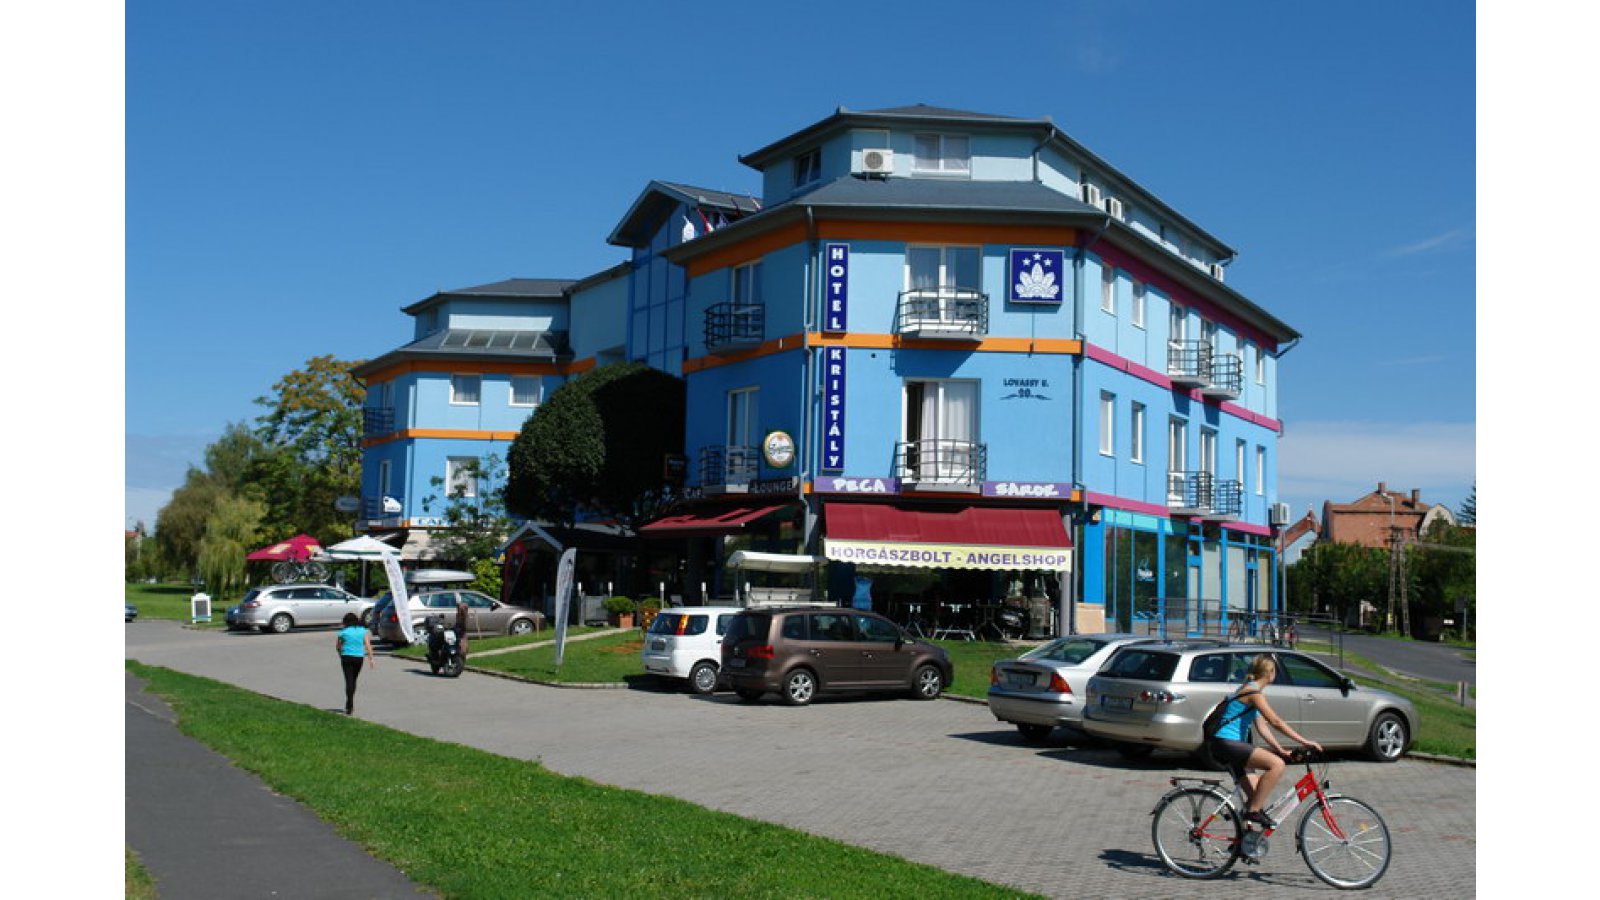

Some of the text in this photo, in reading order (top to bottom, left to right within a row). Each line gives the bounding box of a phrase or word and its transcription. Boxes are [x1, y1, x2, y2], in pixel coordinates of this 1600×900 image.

[830, 247, 845, 329] HOTEL
[828, 349, 843, 467] KRISTÁLY
[832, 478, 887, 494] PECA
[831, 545, 952, 563] HORGÁSZBOLT
[965, 552, 1067, 568] ANGELSHOP
